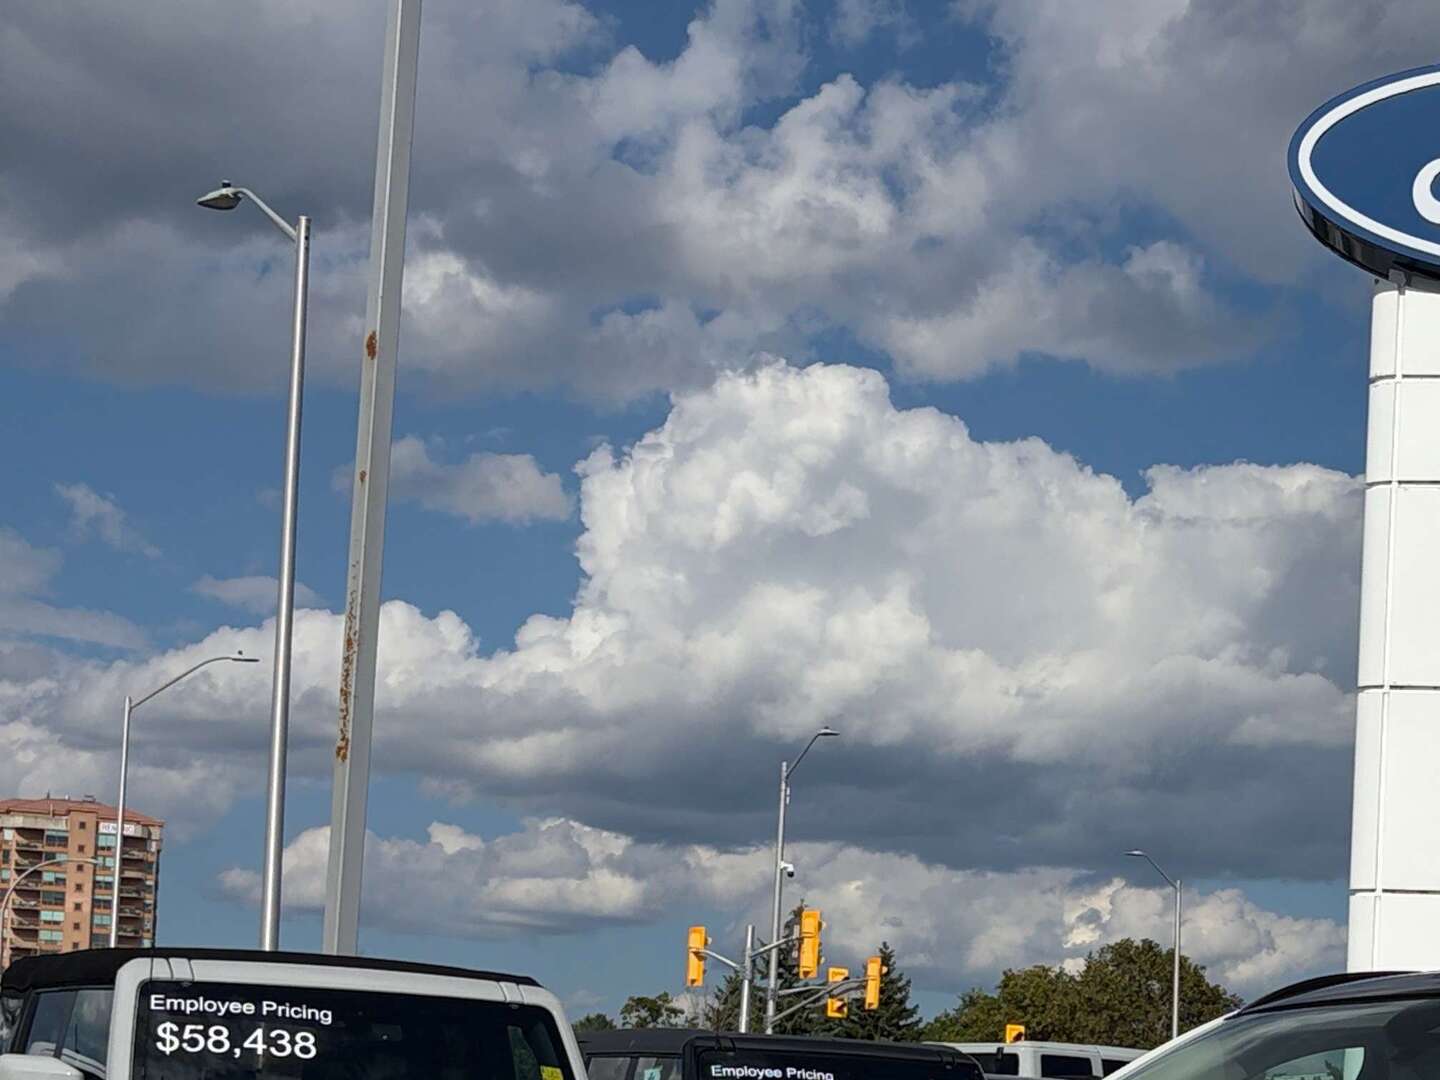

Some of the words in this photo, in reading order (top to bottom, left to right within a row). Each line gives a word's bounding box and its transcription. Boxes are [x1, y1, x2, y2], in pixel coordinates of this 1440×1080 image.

[150, 994, 256, 1016] Employee
[262, 1000, 333, 1025] Pricing
[155, 1021, 317, 1059] $58,438
[710, 1065, 782, 1080] Employee
